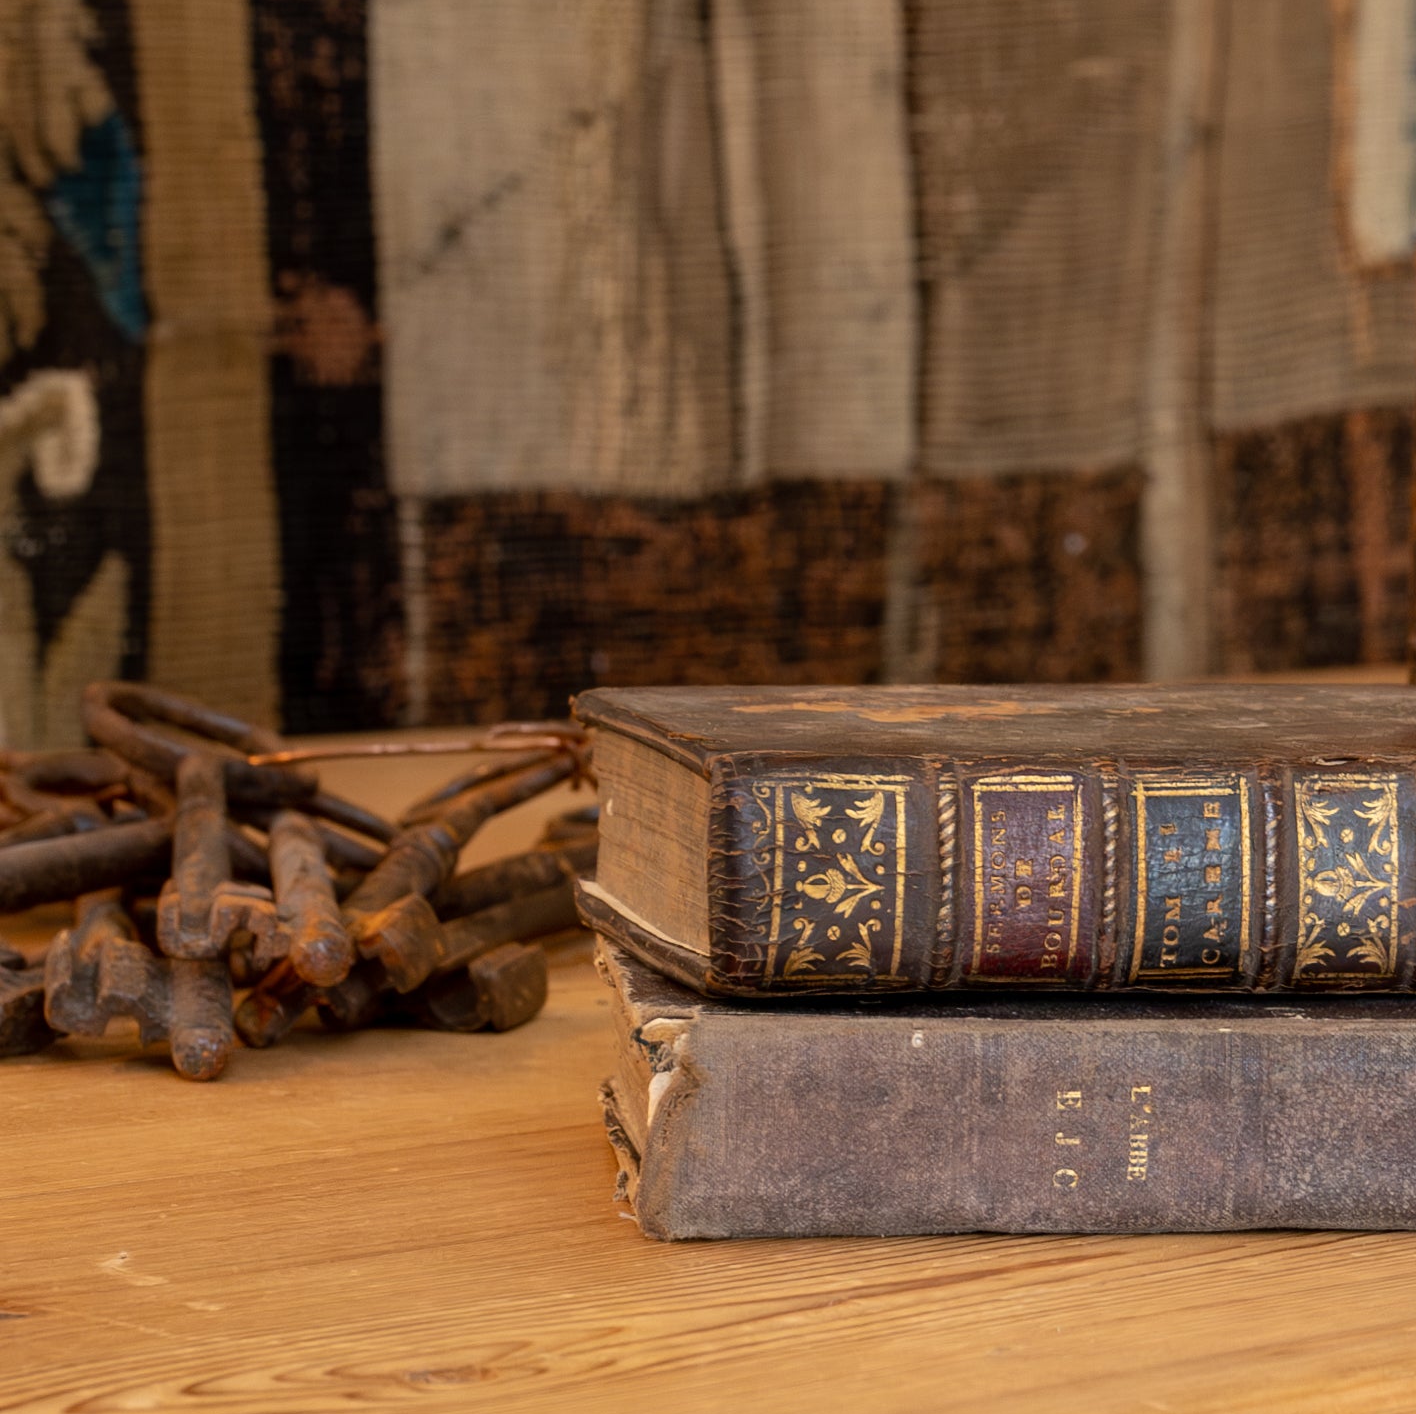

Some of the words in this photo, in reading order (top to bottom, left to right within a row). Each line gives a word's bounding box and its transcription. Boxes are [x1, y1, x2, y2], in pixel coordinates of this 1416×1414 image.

[986, 810, 1007, 953] SERMONS
[1014, 858, 1034, 909] DE
[1041, 804, 1067, 969] BOURDAL
[1159, 895, 1182, 967] TOM
[1056, 1090, 1082, 1110] E
[1127, 1086, 1152, 1181] L'ABBE
[1052, 1168, 1079, 1188] C
